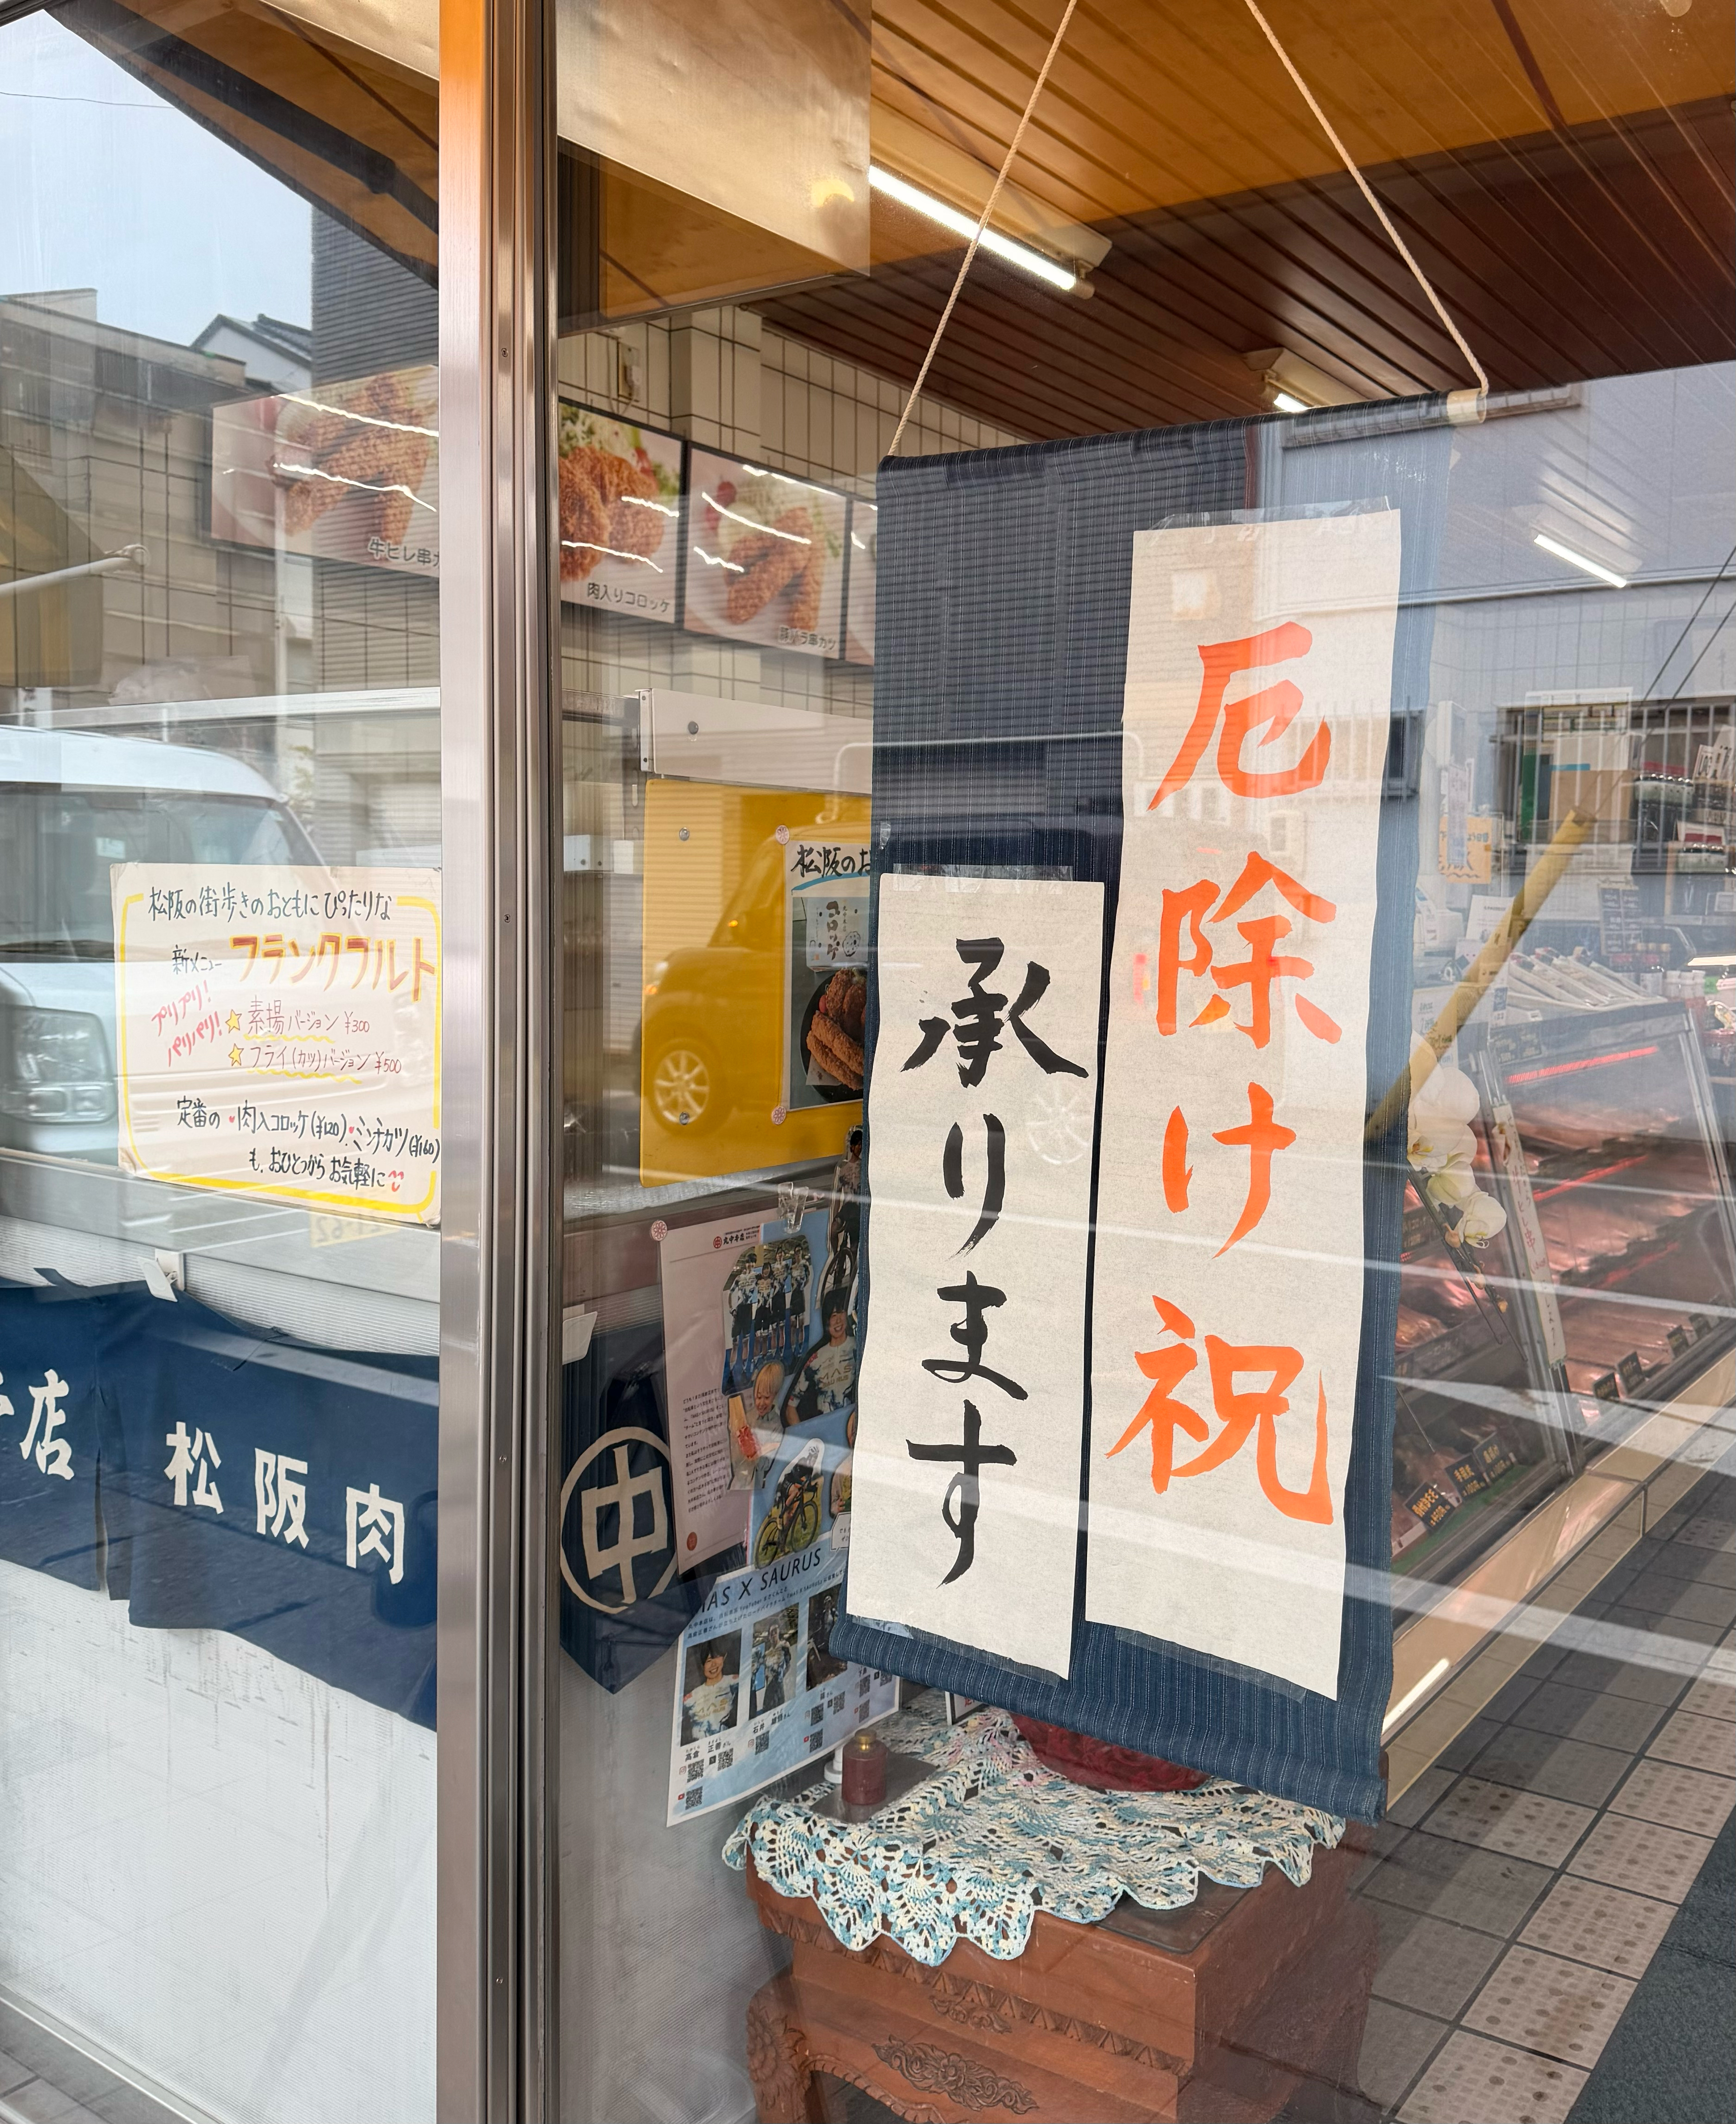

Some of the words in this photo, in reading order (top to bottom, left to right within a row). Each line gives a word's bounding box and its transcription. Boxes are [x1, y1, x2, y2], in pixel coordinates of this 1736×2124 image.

[587, 582, 670, 613] 肉入りコロッケ
[148, 882, 392, 923] 松阪の街歩きのおともにぴったりな
[172, 944, 222, 975] 新メニュー
[230, 932, 435, 1001] フランクフルト
[344, 1011, 370, 1035] ¥300
[374, 1051, 401, 1075] ¥500
[1105, 621, 1342, 1524] 厄除け祝
[177, 1095, 220, 1129] 定番の
[900, 938, 1089, 1590] 承ります
[0, 1369, 74, 1480] 店
[164, 1421, 404, 1584] 松阪肉
[738, 1577, 753, 1600] X
[760, 1548, 821, 1591] SAURUS
